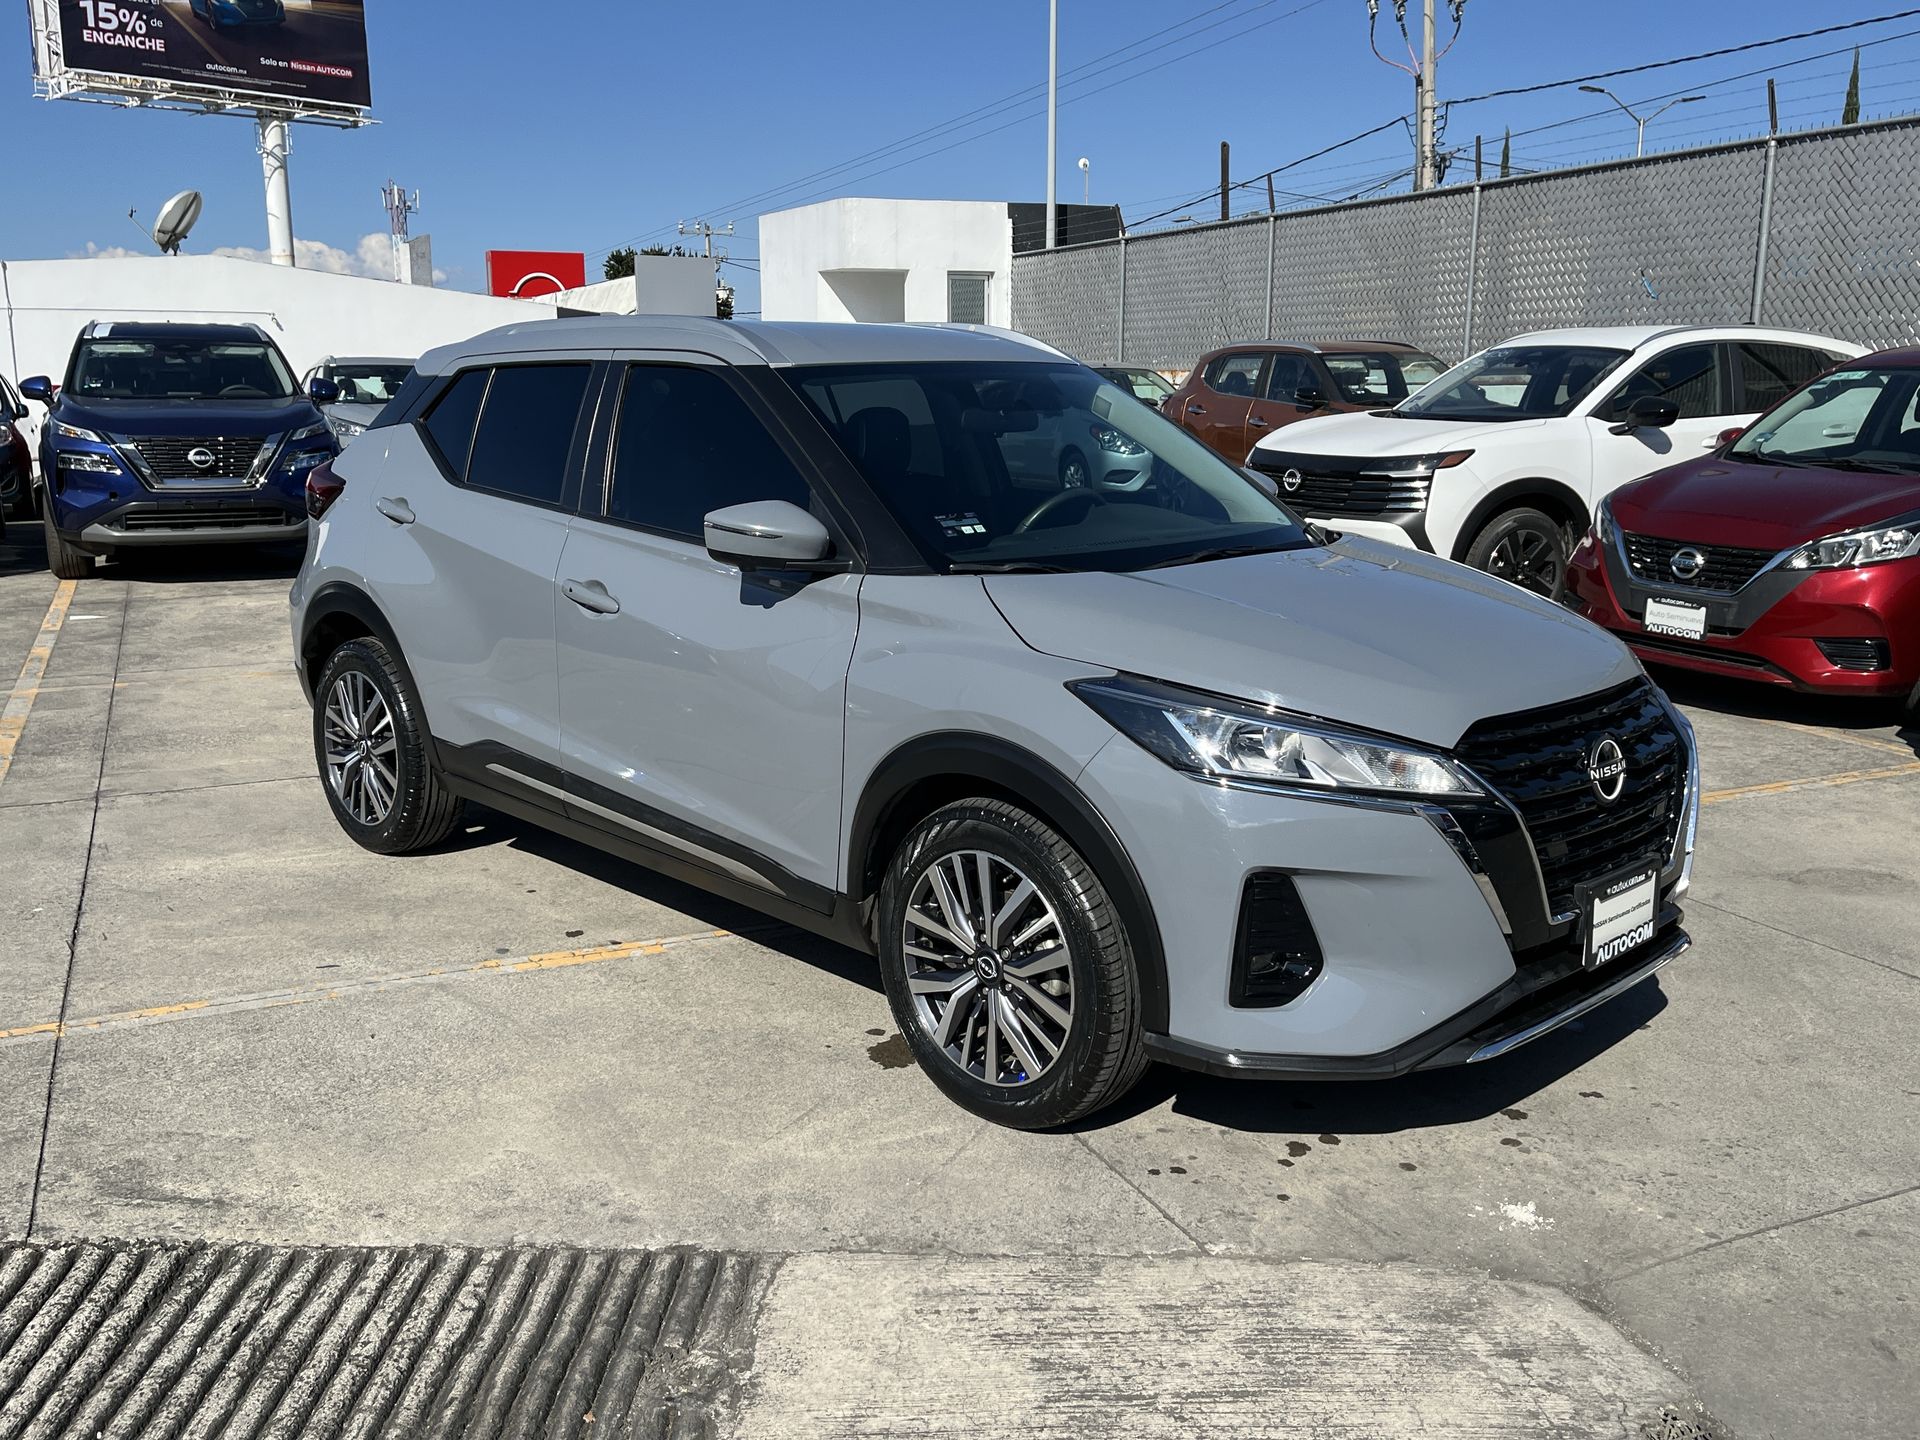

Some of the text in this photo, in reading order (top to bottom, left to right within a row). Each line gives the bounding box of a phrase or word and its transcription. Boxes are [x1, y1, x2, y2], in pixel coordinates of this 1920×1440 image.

[151, 18, 163, 27] de
[83, 29, 166, 52] ENGANCHE
[260, 57, 277, 67] Solo
[291, 62, 316, 72] Nissan
[316, 66, 353, 77] AUTOCOM
[1647, 623, 1700, 640] AUTOCOM
[1590, 759, 1626, 780] NISSAN
[1596, 920, 1654, 966] AUTOCOM
